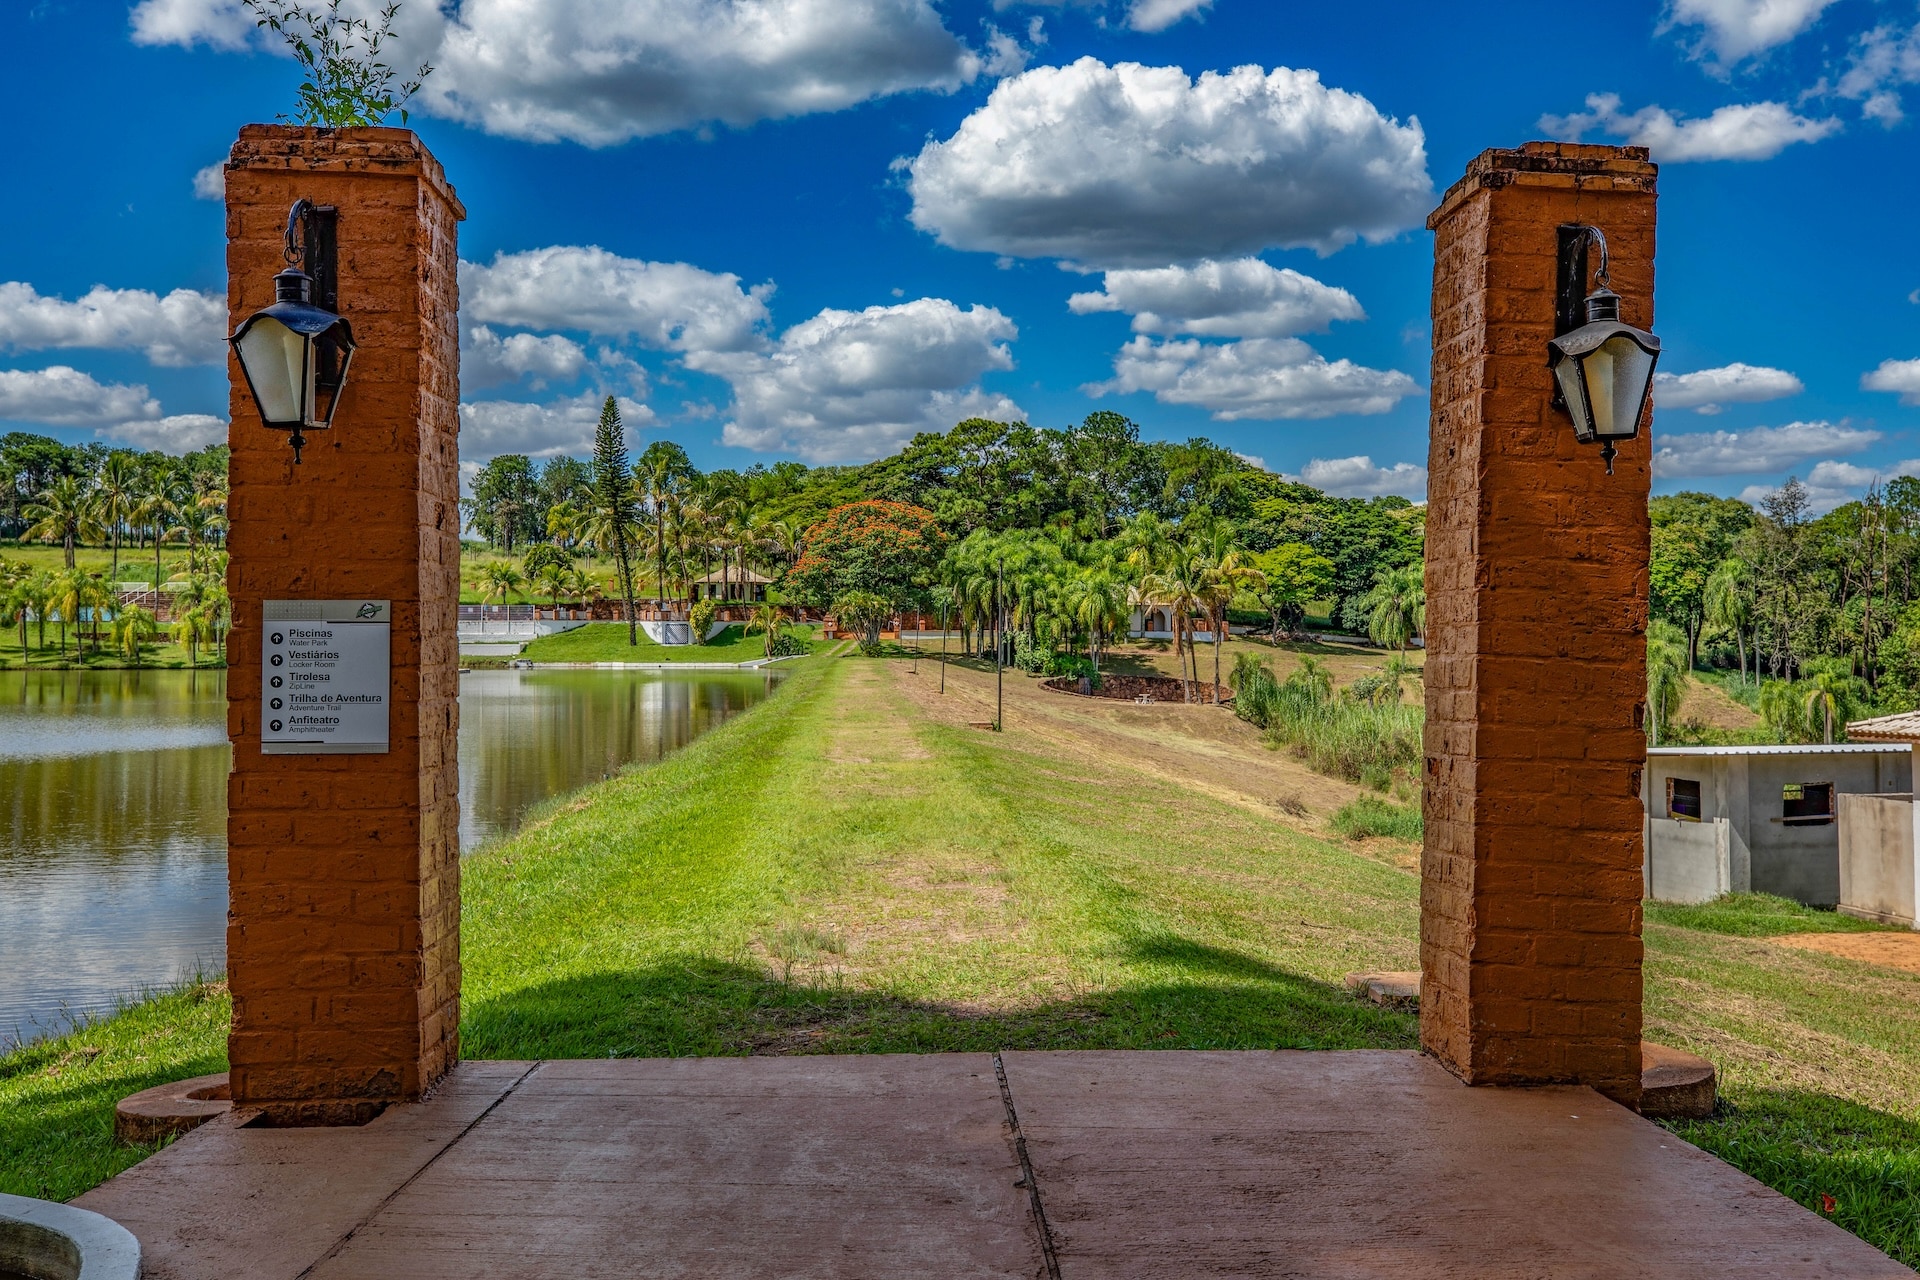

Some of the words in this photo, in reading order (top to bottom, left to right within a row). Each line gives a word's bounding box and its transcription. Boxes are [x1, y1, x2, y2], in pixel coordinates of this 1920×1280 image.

[289, 629, 333, 638] Piscinas
[288, 651, 340, 659] Vestiários
[289, 672, 330, 681] Tirolesa
[289, 694, 318, 703] Trilha
[320, 694, 333, 703] de
[336, 694, 382, 702] Aventura
[288, 716, 340, 724] Anfiteatro
